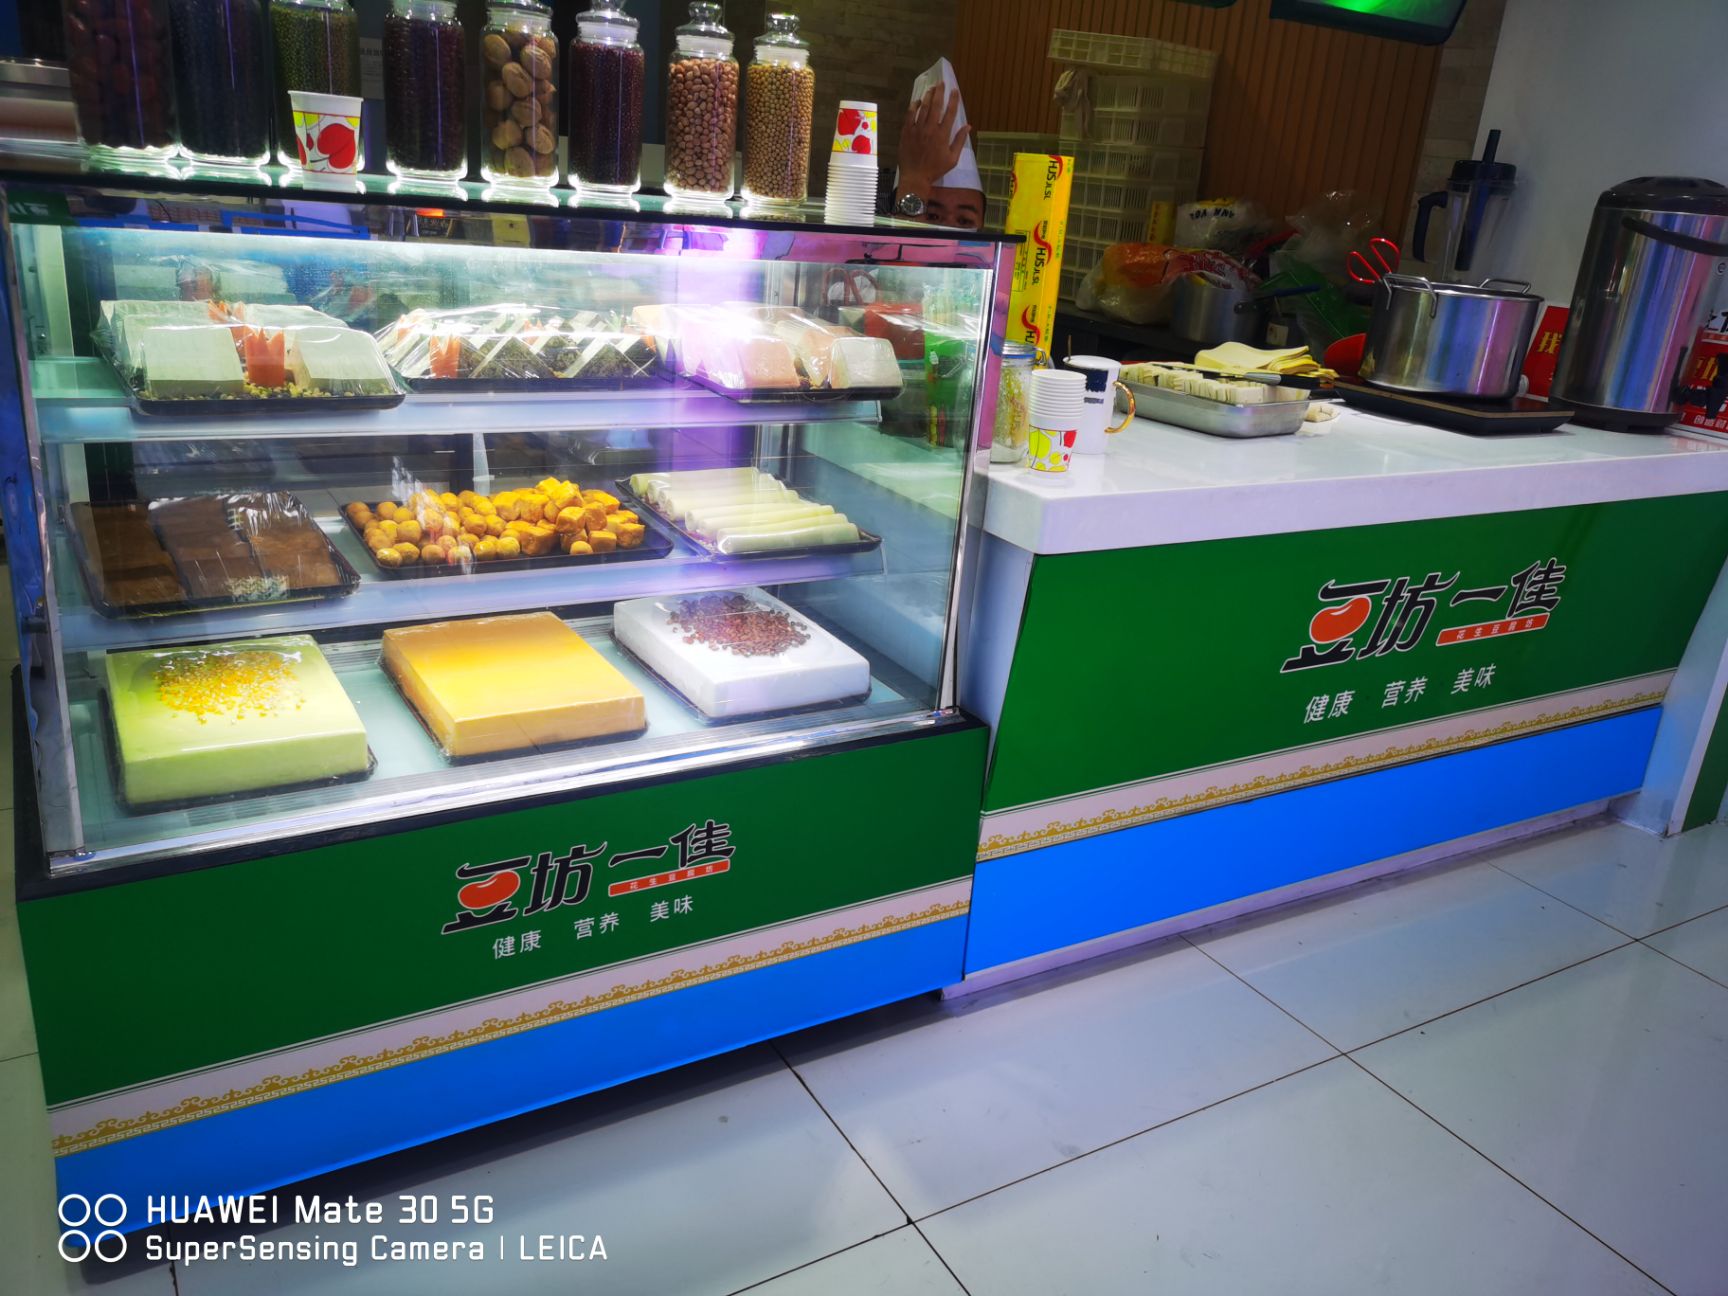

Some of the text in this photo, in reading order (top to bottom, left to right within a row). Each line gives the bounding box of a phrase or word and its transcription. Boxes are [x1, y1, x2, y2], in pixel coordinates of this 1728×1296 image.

[1280, 558, 1566, 673] 豆坊一佳
[1303, 662, 1496, 724] 健康 营养 美味
[441, 819, 736, 935] 豆坊一佳
[492, 895, 694, 960] 健康 营养 美味
